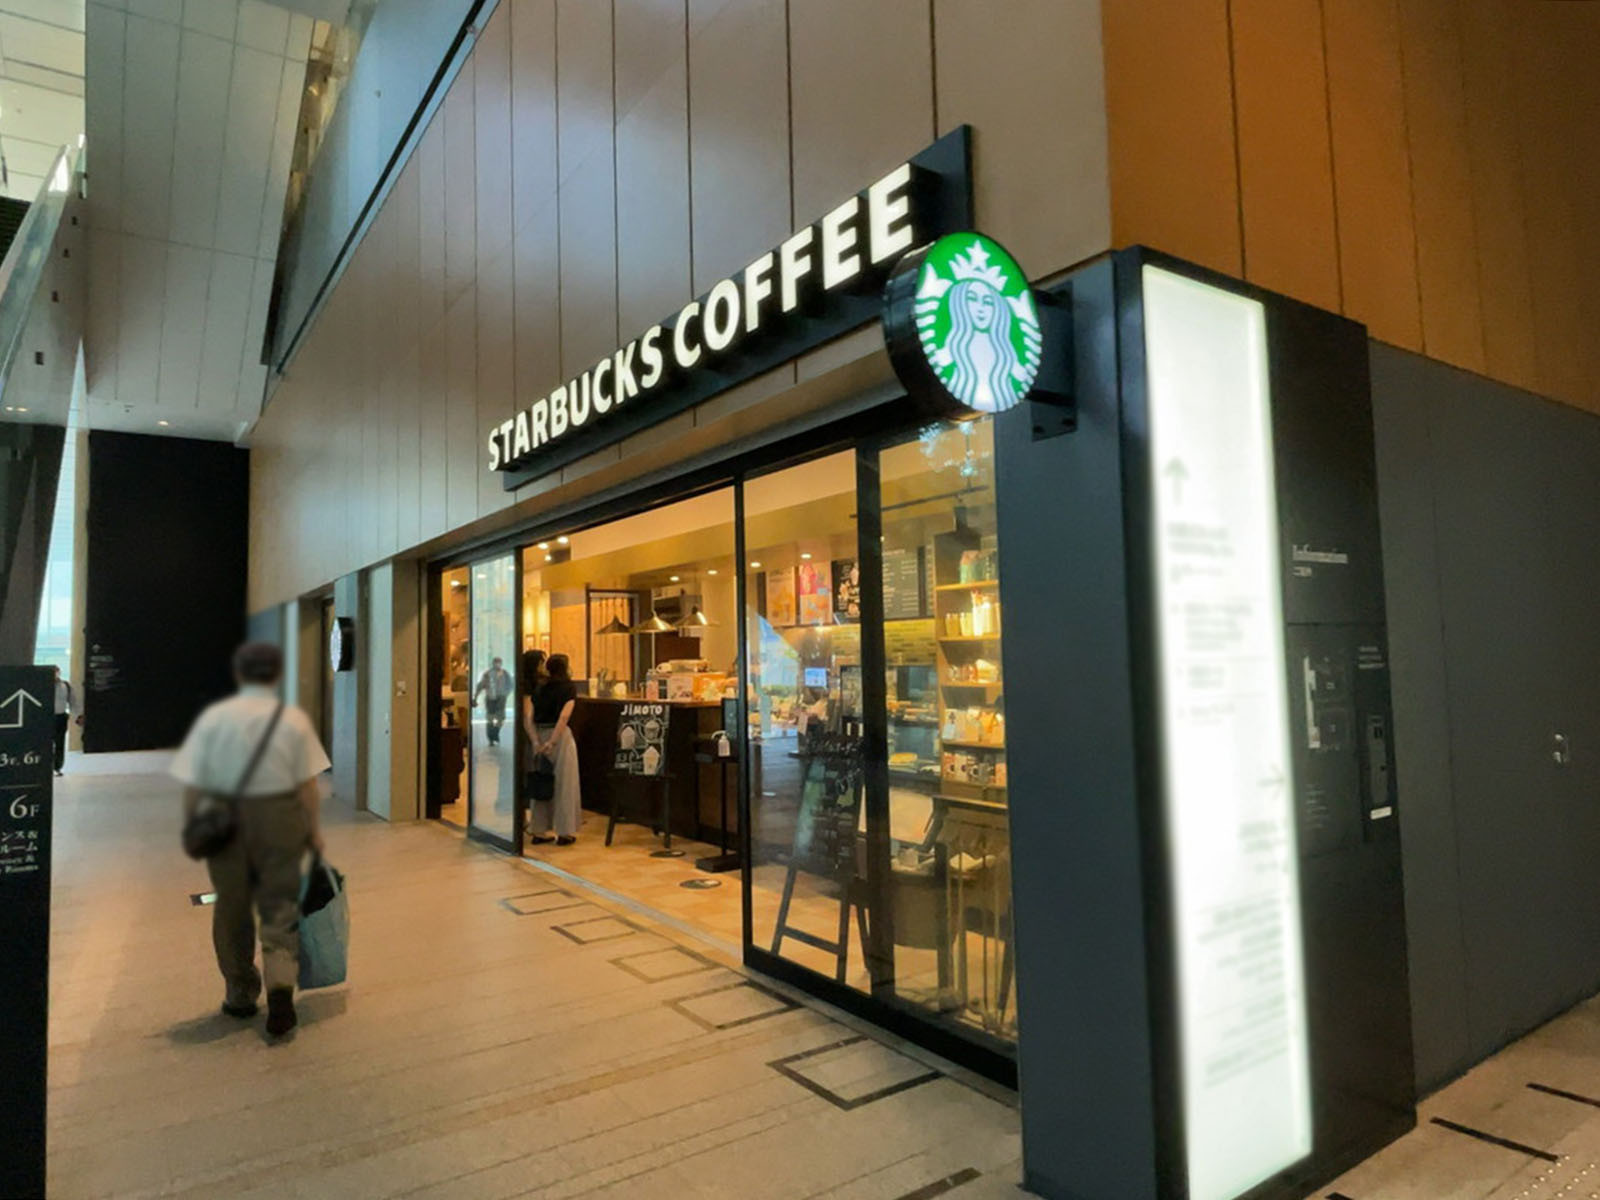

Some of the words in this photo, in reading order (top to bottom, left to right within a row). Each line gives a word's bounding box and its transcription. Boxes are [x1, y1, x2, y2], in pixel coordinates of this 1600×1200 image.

[488, 323, 663, 472] STARBUCKS
[673, 162, 913, 369] COFFEE
[9, 794, 40, 819] 6F
